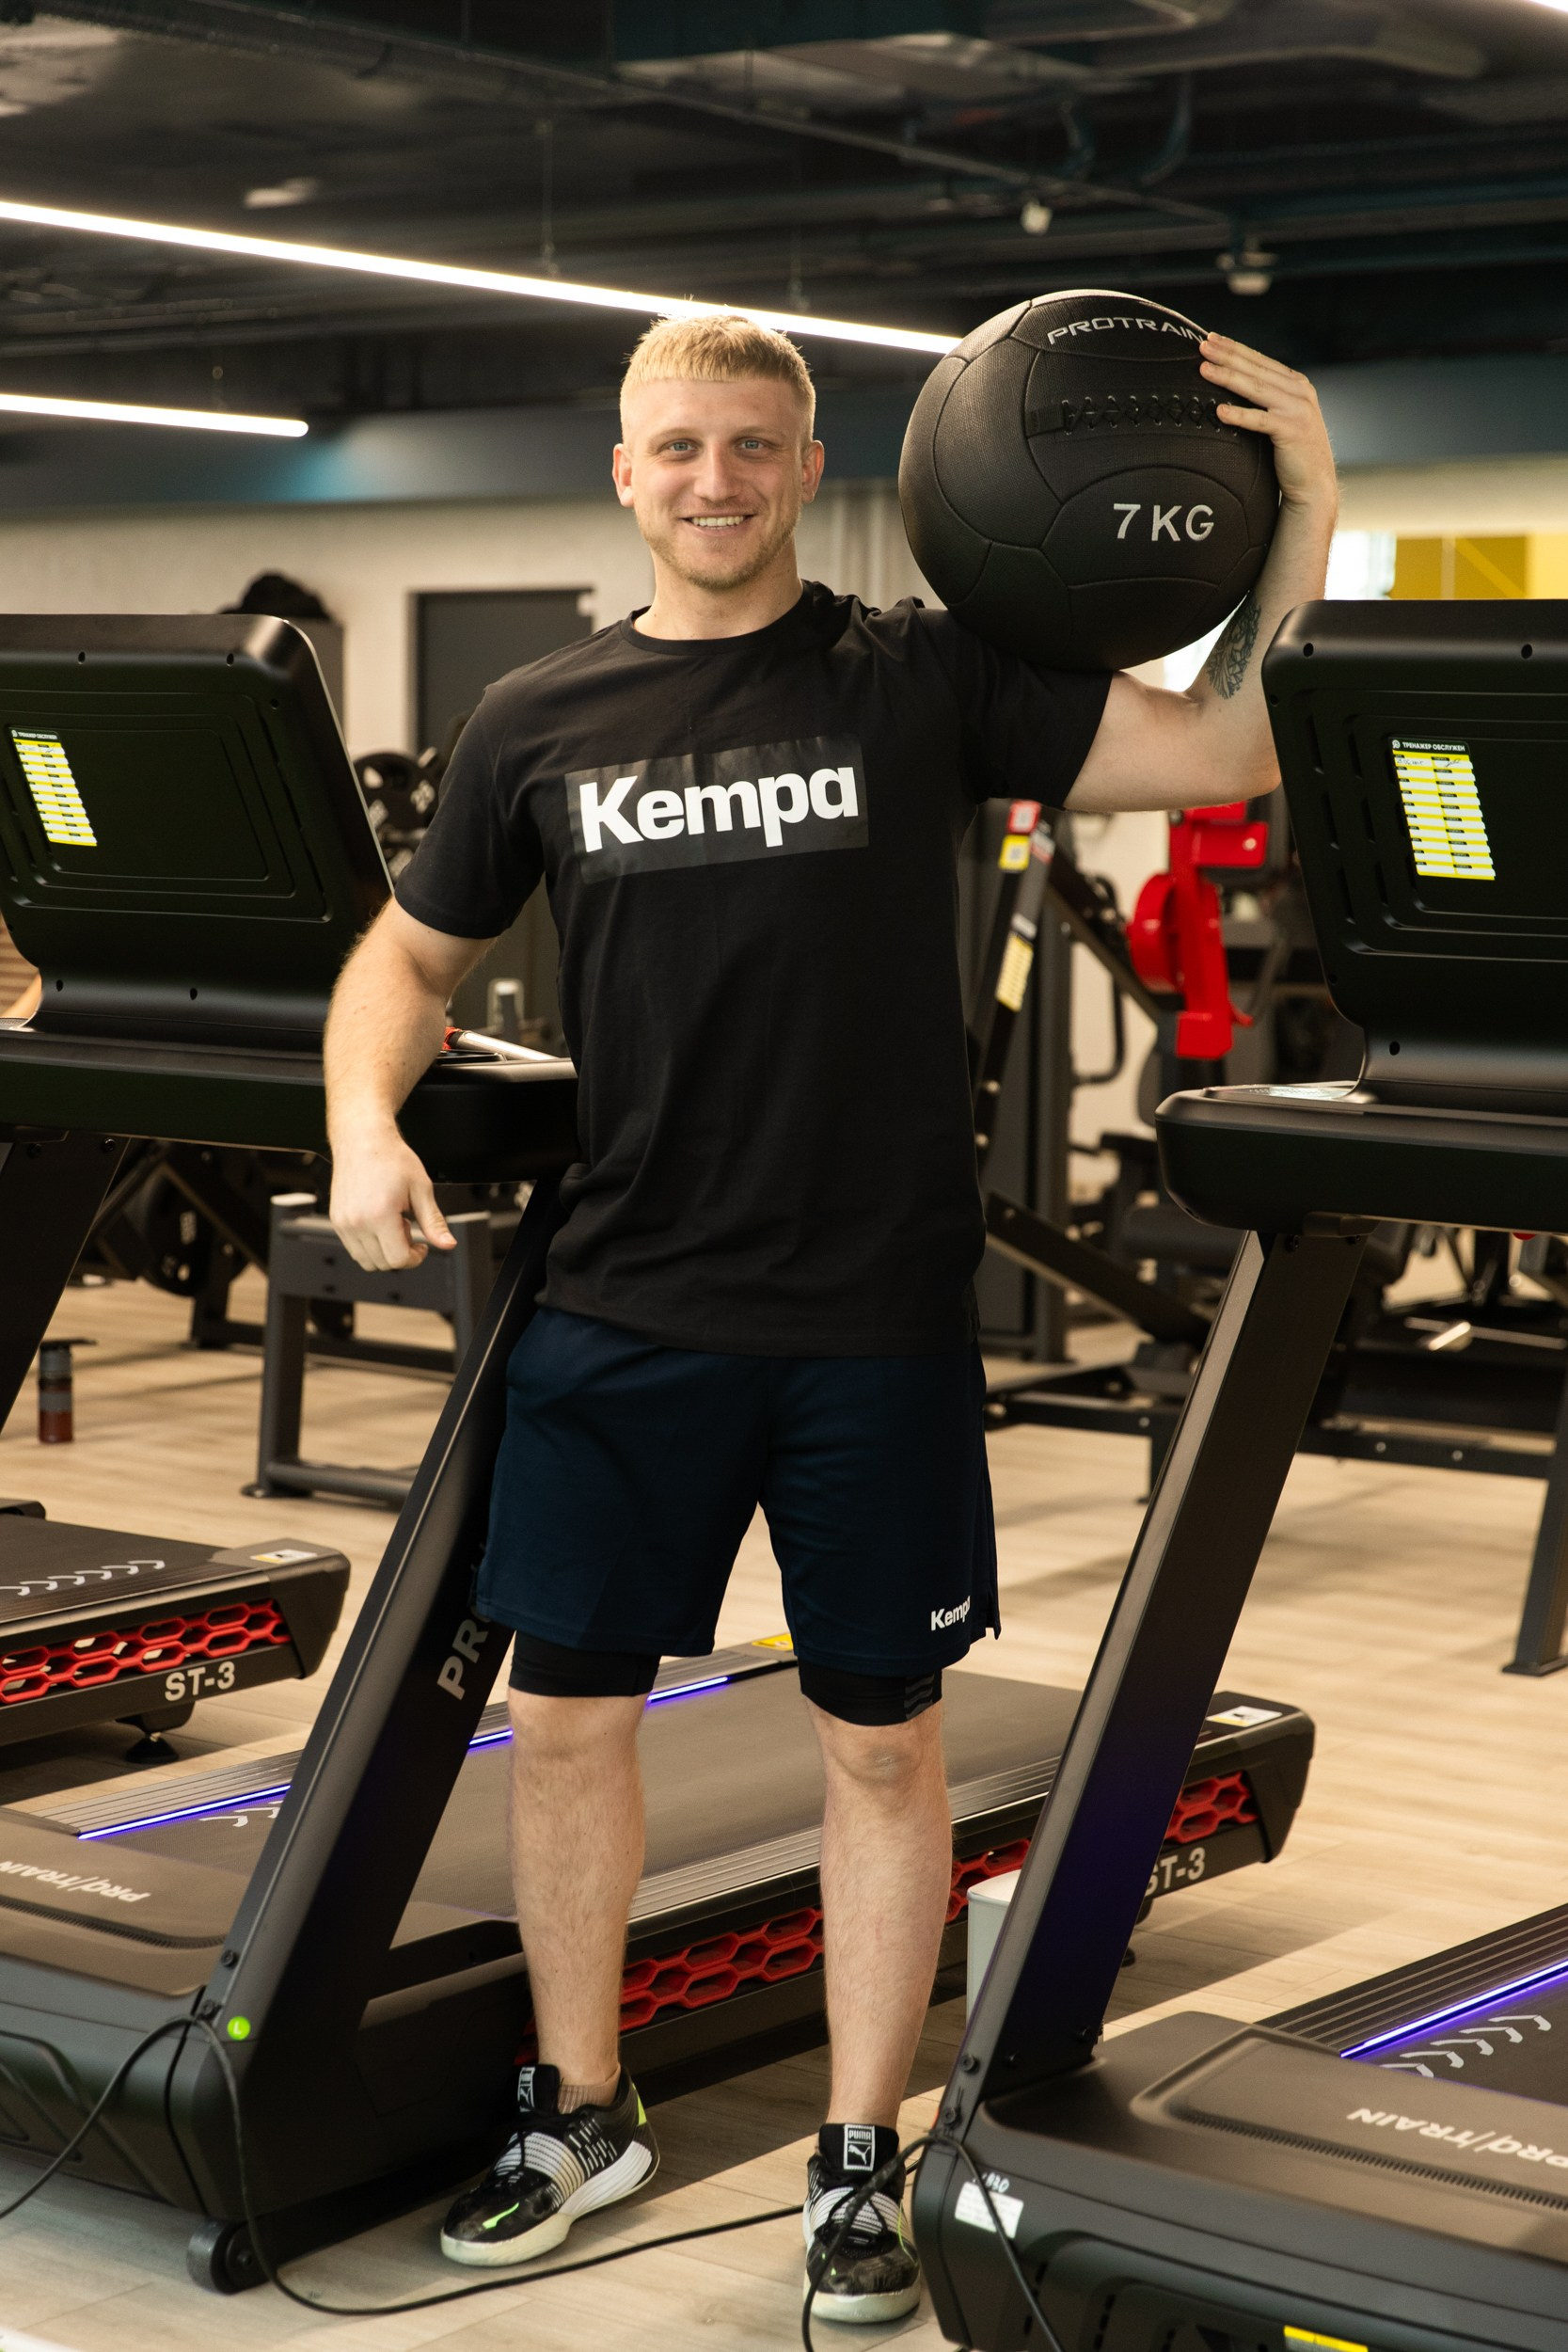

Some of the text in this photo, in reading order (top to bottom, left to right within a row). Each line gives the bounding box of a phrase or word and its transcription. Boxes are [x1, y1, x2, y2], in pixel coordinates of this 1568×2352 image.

[1047, 317, 1205, 345] PROTRAIN
[1114, 503, 1214, 542] 7 KG
[579, 767, 858, 852] Kempa
[165, 1661, 235, 1701] ST-3
